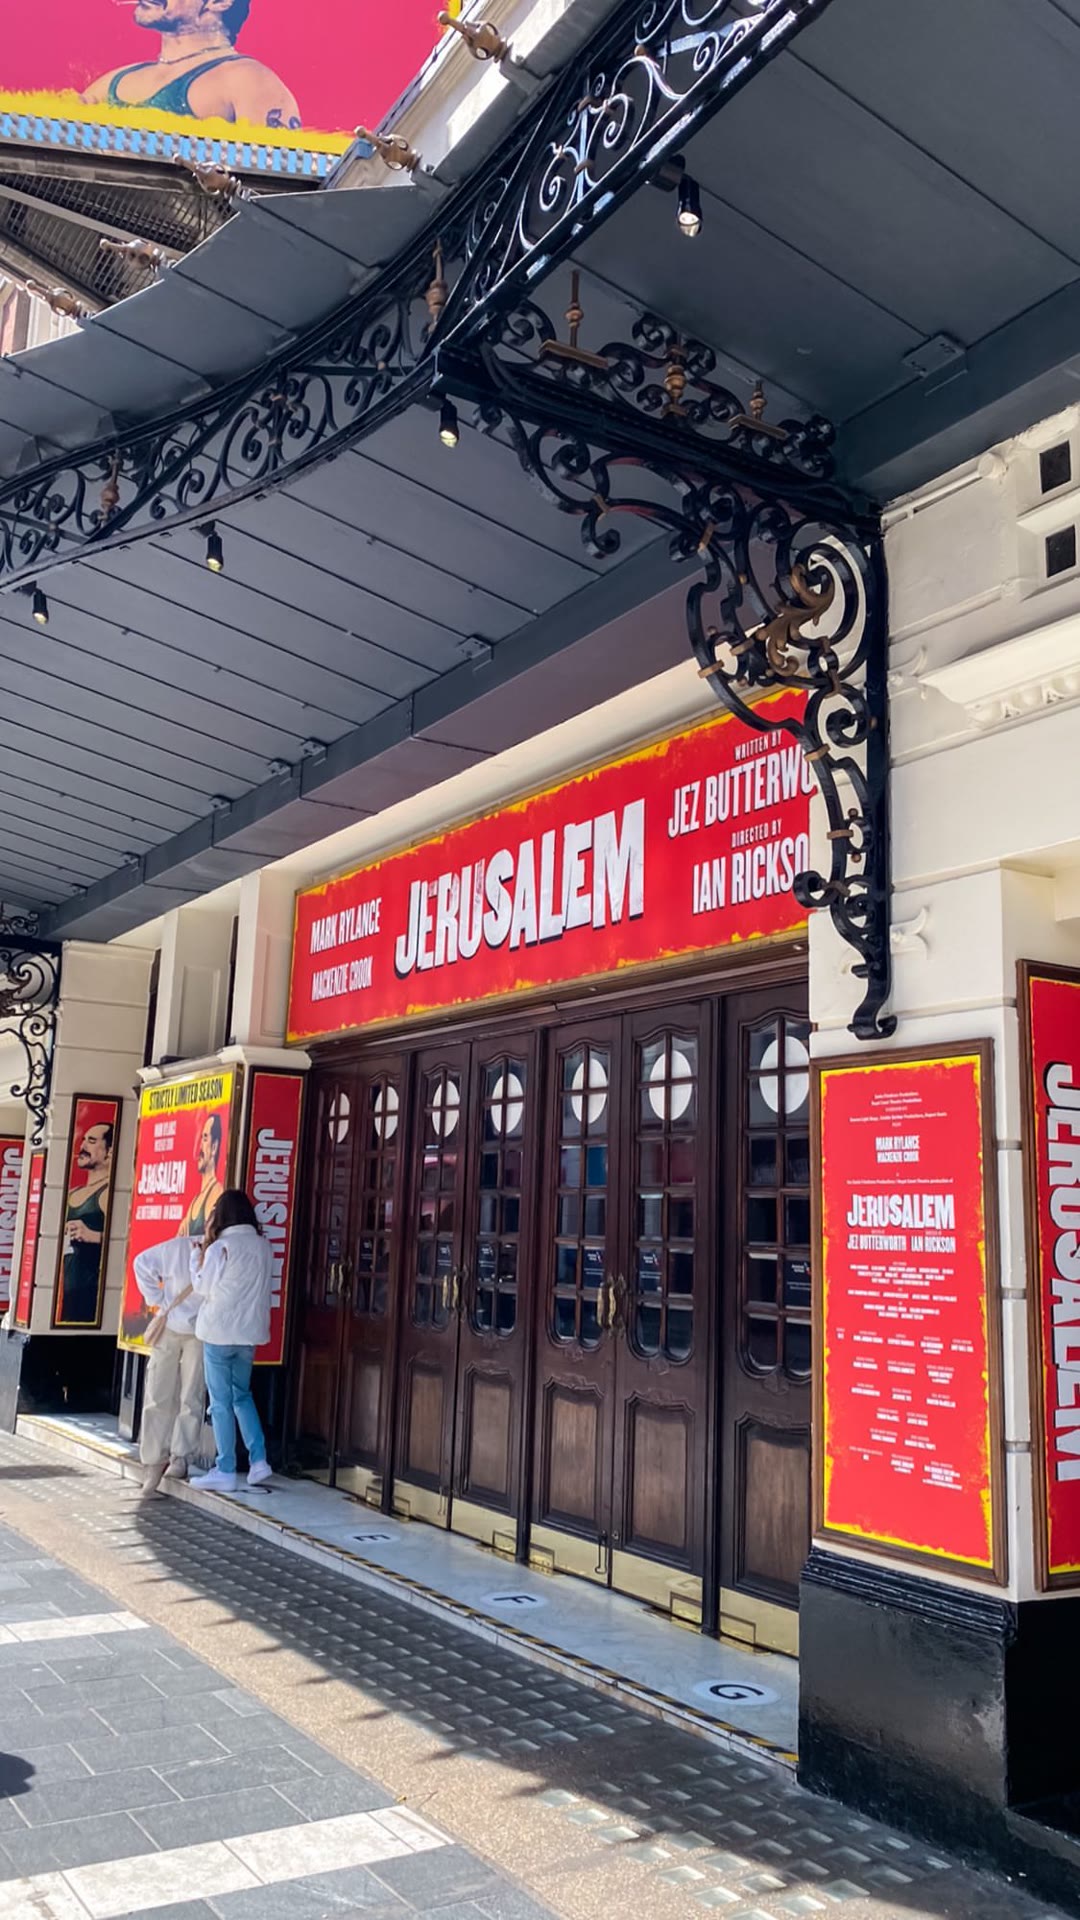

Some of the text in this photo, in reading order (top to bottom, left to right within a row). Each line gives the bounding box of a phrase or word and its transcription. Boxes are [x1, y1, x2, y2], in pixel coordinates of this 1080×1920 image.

[734, 730, 782, 762] WRITTEN BY
[667, 780, 702, 839] JEZ
[731, 818, 782, 849] DIRECTED BY
[394, 799, 645, 977] JERUSALEM
[692, 856, 727, 915] IAN
[310, 897, 382, 955] MARK RYLANCE
[311, 963, 349, 1002] MACKENZIE
[149, 1077, 224, 1111] STRICTLY LIMITED SEASON
[138, 1161, 186, 1195] JERUSALEM
[847, 1194, 955, 1229] JERUSALEM
[847, 1234, 860, 1250] JEZ
[911, 1236, 924, 1253] IAN
[353, 1533, 391, 1543] E
[493, 1594, 537, 1605] F
[708, 1684, 765, 1701] G
